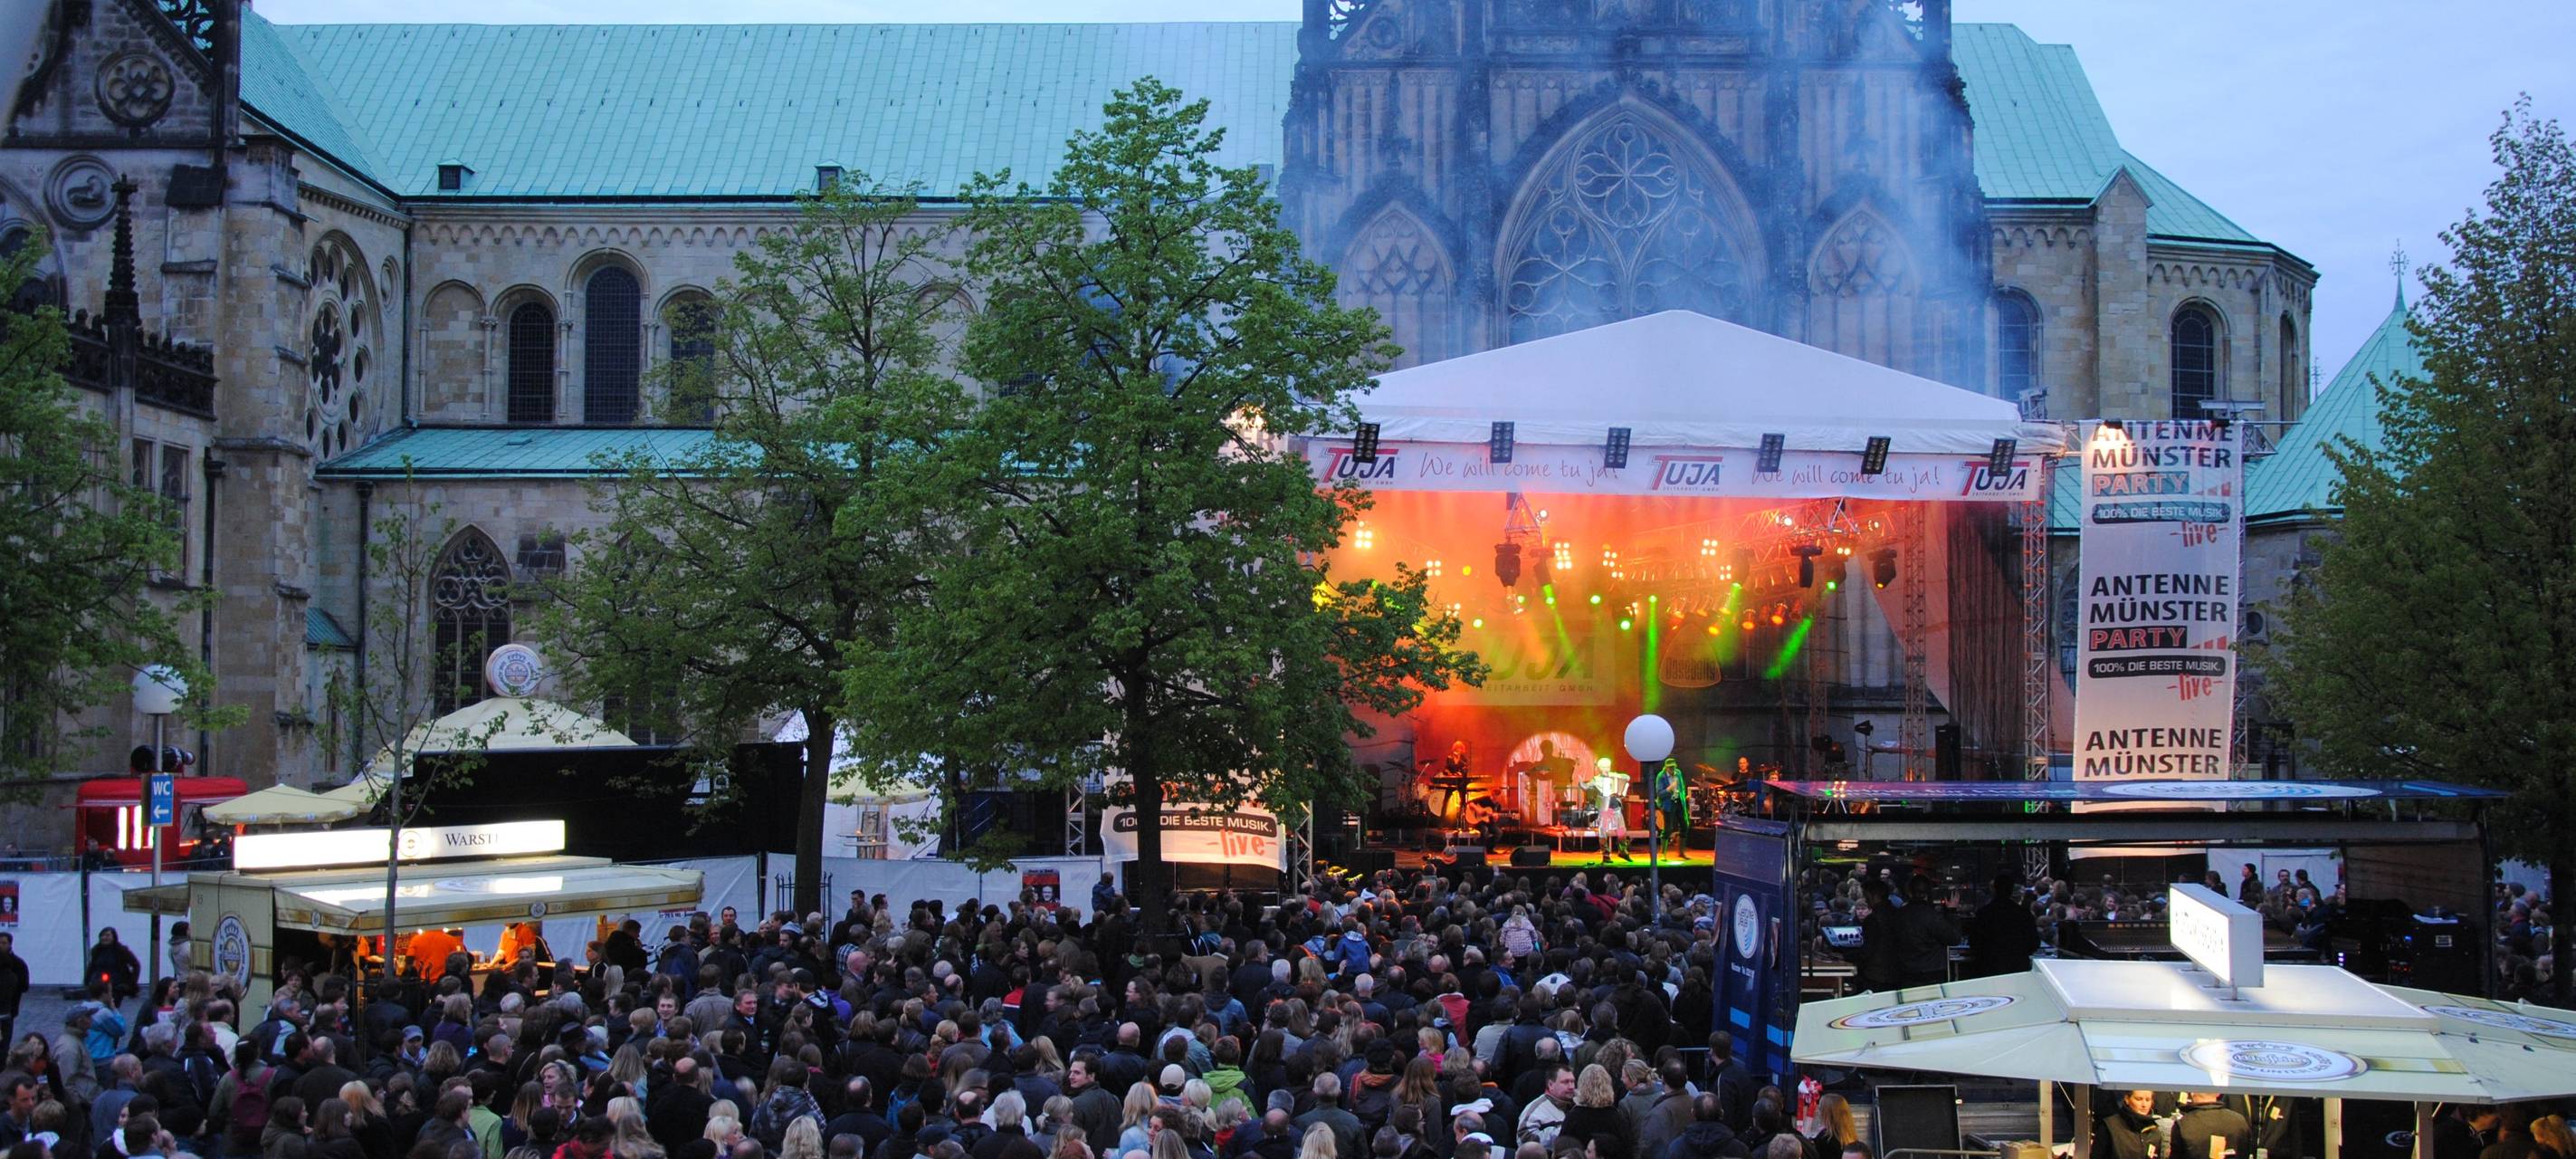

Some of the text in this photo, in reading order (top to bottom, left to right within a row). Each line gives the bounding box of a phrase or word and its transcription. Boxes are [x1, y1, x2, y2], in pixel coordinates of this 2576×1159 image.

[1322, 447, 1399, 483] TUJA
[1419, 455, 1453, 479] We
[1463, 455, 1494, 478] will
[1504, 462, 1550, 479] come
[1560, 459, 1580, 478] tu
[2093, 443, 2231, 468] MÜNSTER
[1651, 455, 1723, 491] TUJA
[1752, 461, 1941, 493] We will come tu ja!
[1961, 461, 2030, 496] TUJA
[2094, 473, 2189, 495] PARTY
[2097, 508, 2128, 519] 100%
[2131, 507, 2148, 517] DIE
[2151, 506, 2185, 517] BESTE
[2091, 574, 2228, 597] ANTENNE
[2089, 598, 2228, 623] MÜNSTER
[2090, 627, 2186, 650] PARTY
[2094, 660, 2221, 674] 100% DIE BESTE MUSIK.
[2085, 728, 2222, 751] ANTENNE
[2084, 752, 2219, 778] MÜNSTER
[153, 781, 171, 796] WC
[1159, 816, 1179, 826] DIE
[1184, 816, 1223, 827] BESTE
[1227, 817, 1273, 832] MUSIK.
